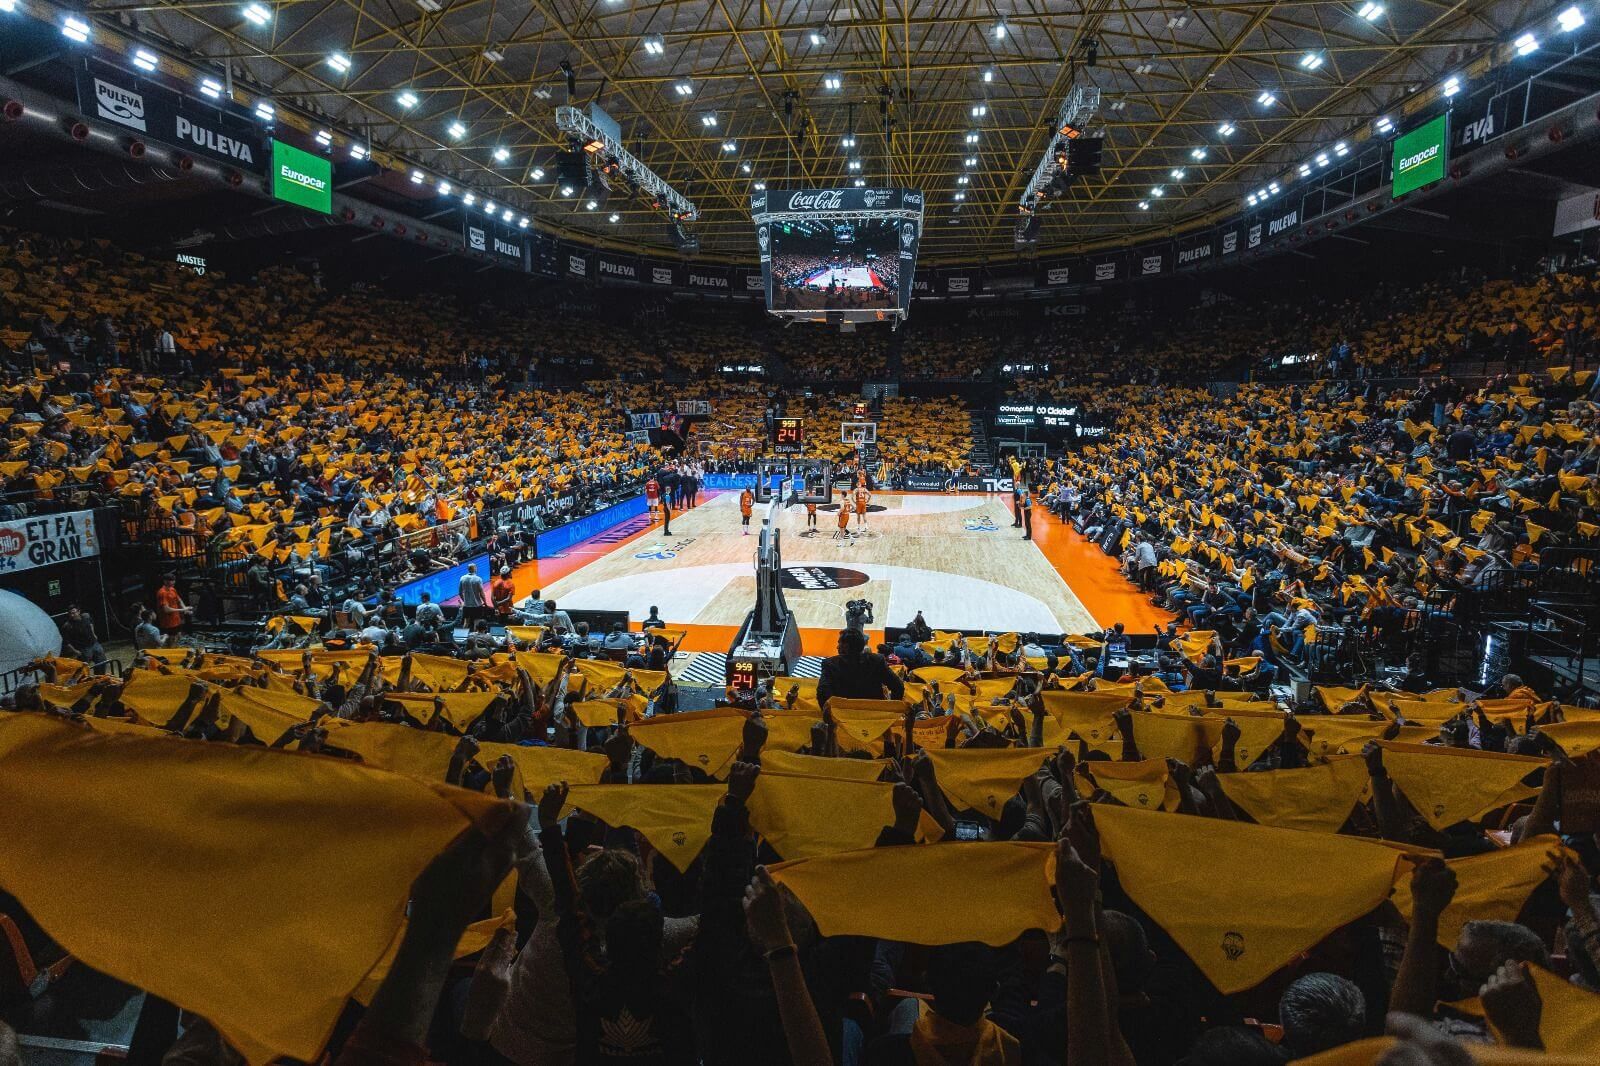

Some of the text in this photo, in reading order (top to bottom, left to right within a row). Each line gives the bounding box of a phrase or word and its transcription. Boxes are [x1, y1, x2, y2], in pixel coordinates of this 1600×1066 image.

[98, 84, 142, 110] PULEVA
[176, 115, 253, 164] PULEVA
[1400, 144, 1440, 170] Europcar
[281, 165, 326, 189] Europcar
[1268, 210, 1297, 236] PULEVA
[494, 238, 520, 258] PULEVA
[1178, 244, 1211, 264] PULEVA
[176, 254, 206, 266] AMSTEL
[600, 260, 636, 276] PULEVA
[689, 274, 728, 287] PULEVA
[778, 429, 796, 442] 24
[704, 476, 758, 487] REATNESS
[982, 478, 1014, 492] TKE
[26, 516, 76, 542] ET FA
[28, 534, 82, 566] GRAN
[732, 674, 752, 688] 24
